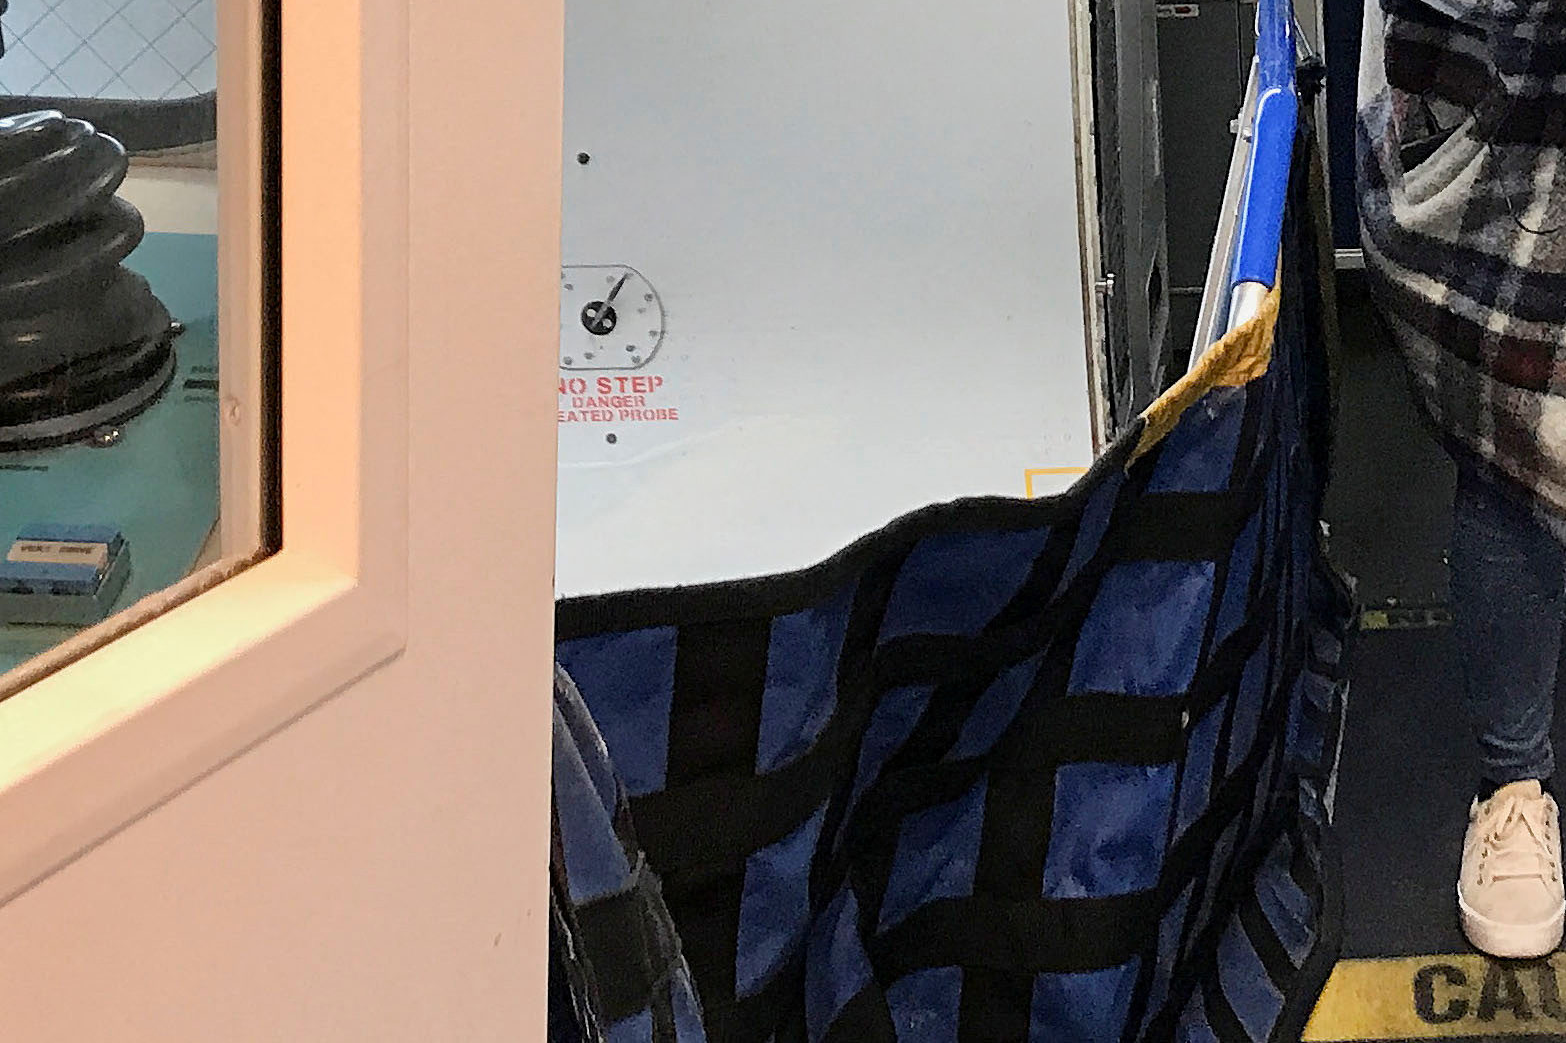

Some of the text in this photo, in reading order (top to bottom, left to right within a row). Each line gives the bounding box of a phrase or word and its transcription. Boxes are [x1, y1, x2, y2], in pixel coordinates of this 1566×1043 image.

[596, 376, 664, 394] STEP
[572, 395, 646, 409] DANGER
[558, 407, 680, 423] EATED PROBE
